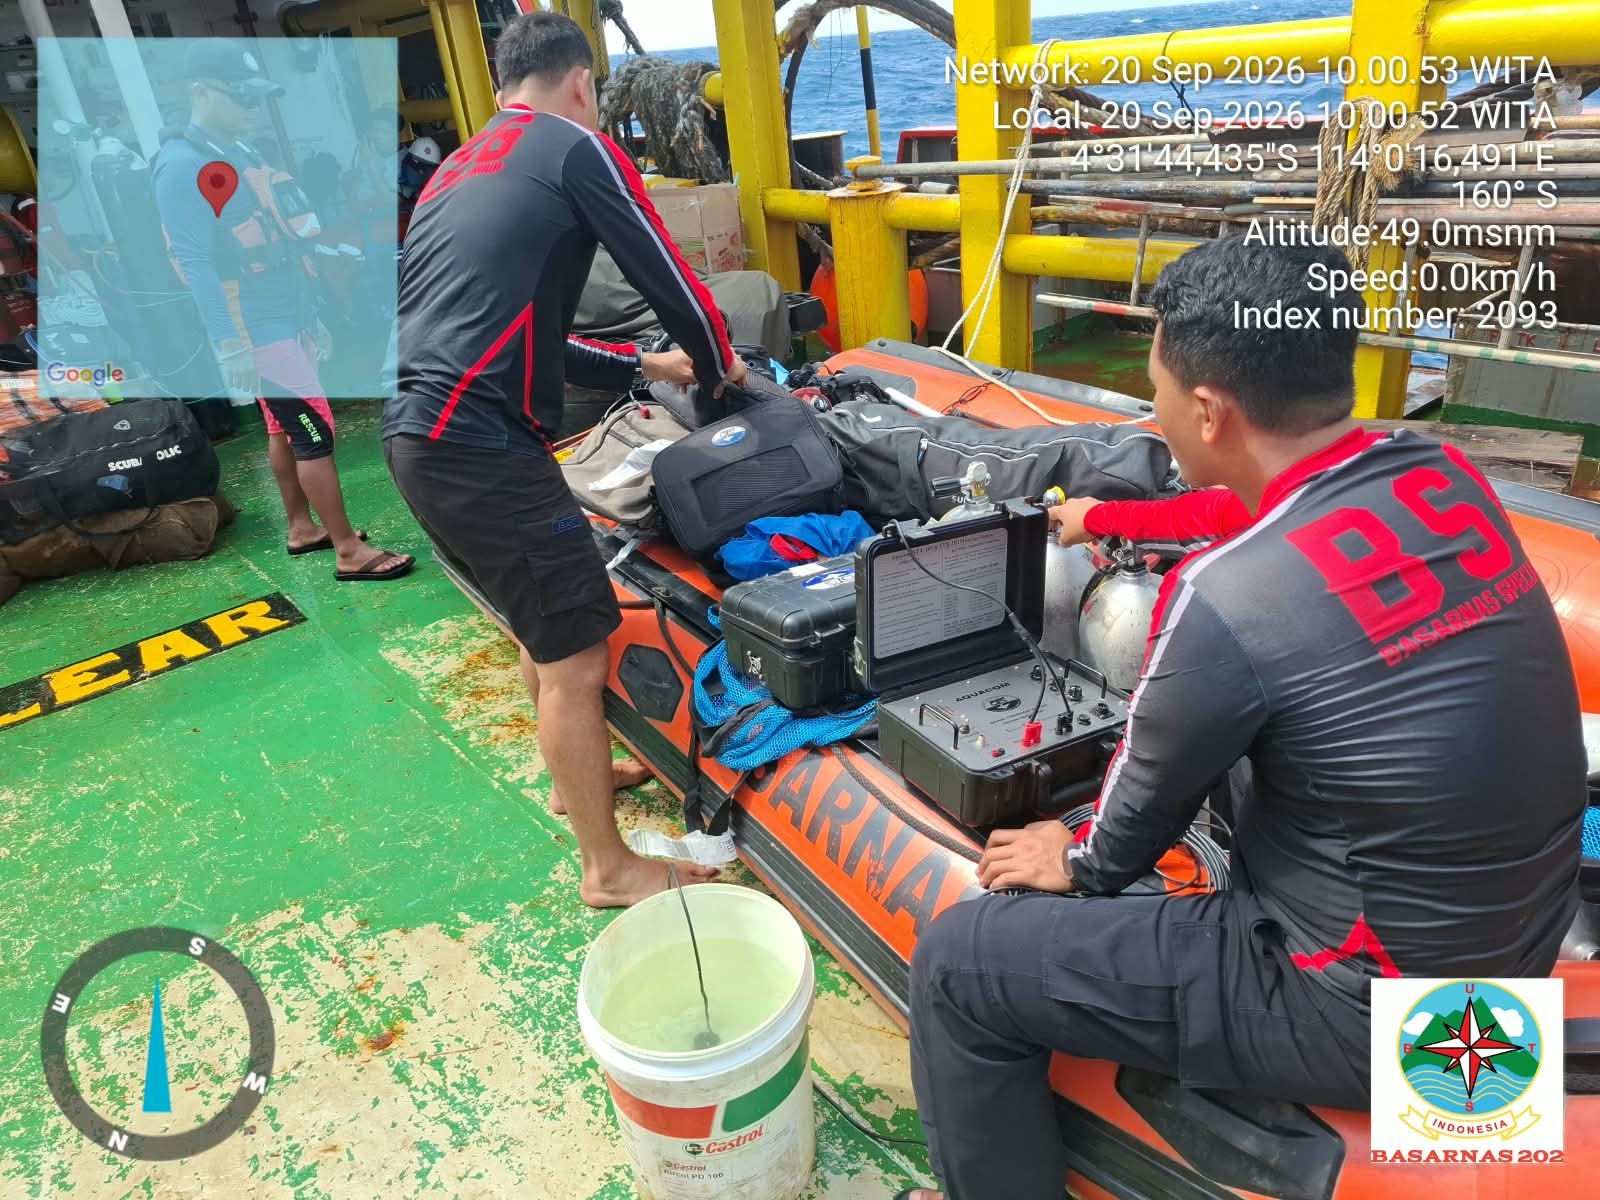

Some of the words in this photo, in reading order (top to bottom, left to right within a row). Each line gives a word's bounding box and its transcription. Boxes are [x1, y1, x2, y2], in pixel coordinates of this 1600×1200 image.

[298, 412, 322, 443] RESCUE
[1283, 441, 1513, 644] BS
[1378, 589, 1502, 667] BASARNAS
[955, 682, 1012, 702] AQUACOM
[705, 1125, 764, 1154] Castrol
[673, 1162, 706, 1172] Castrol
